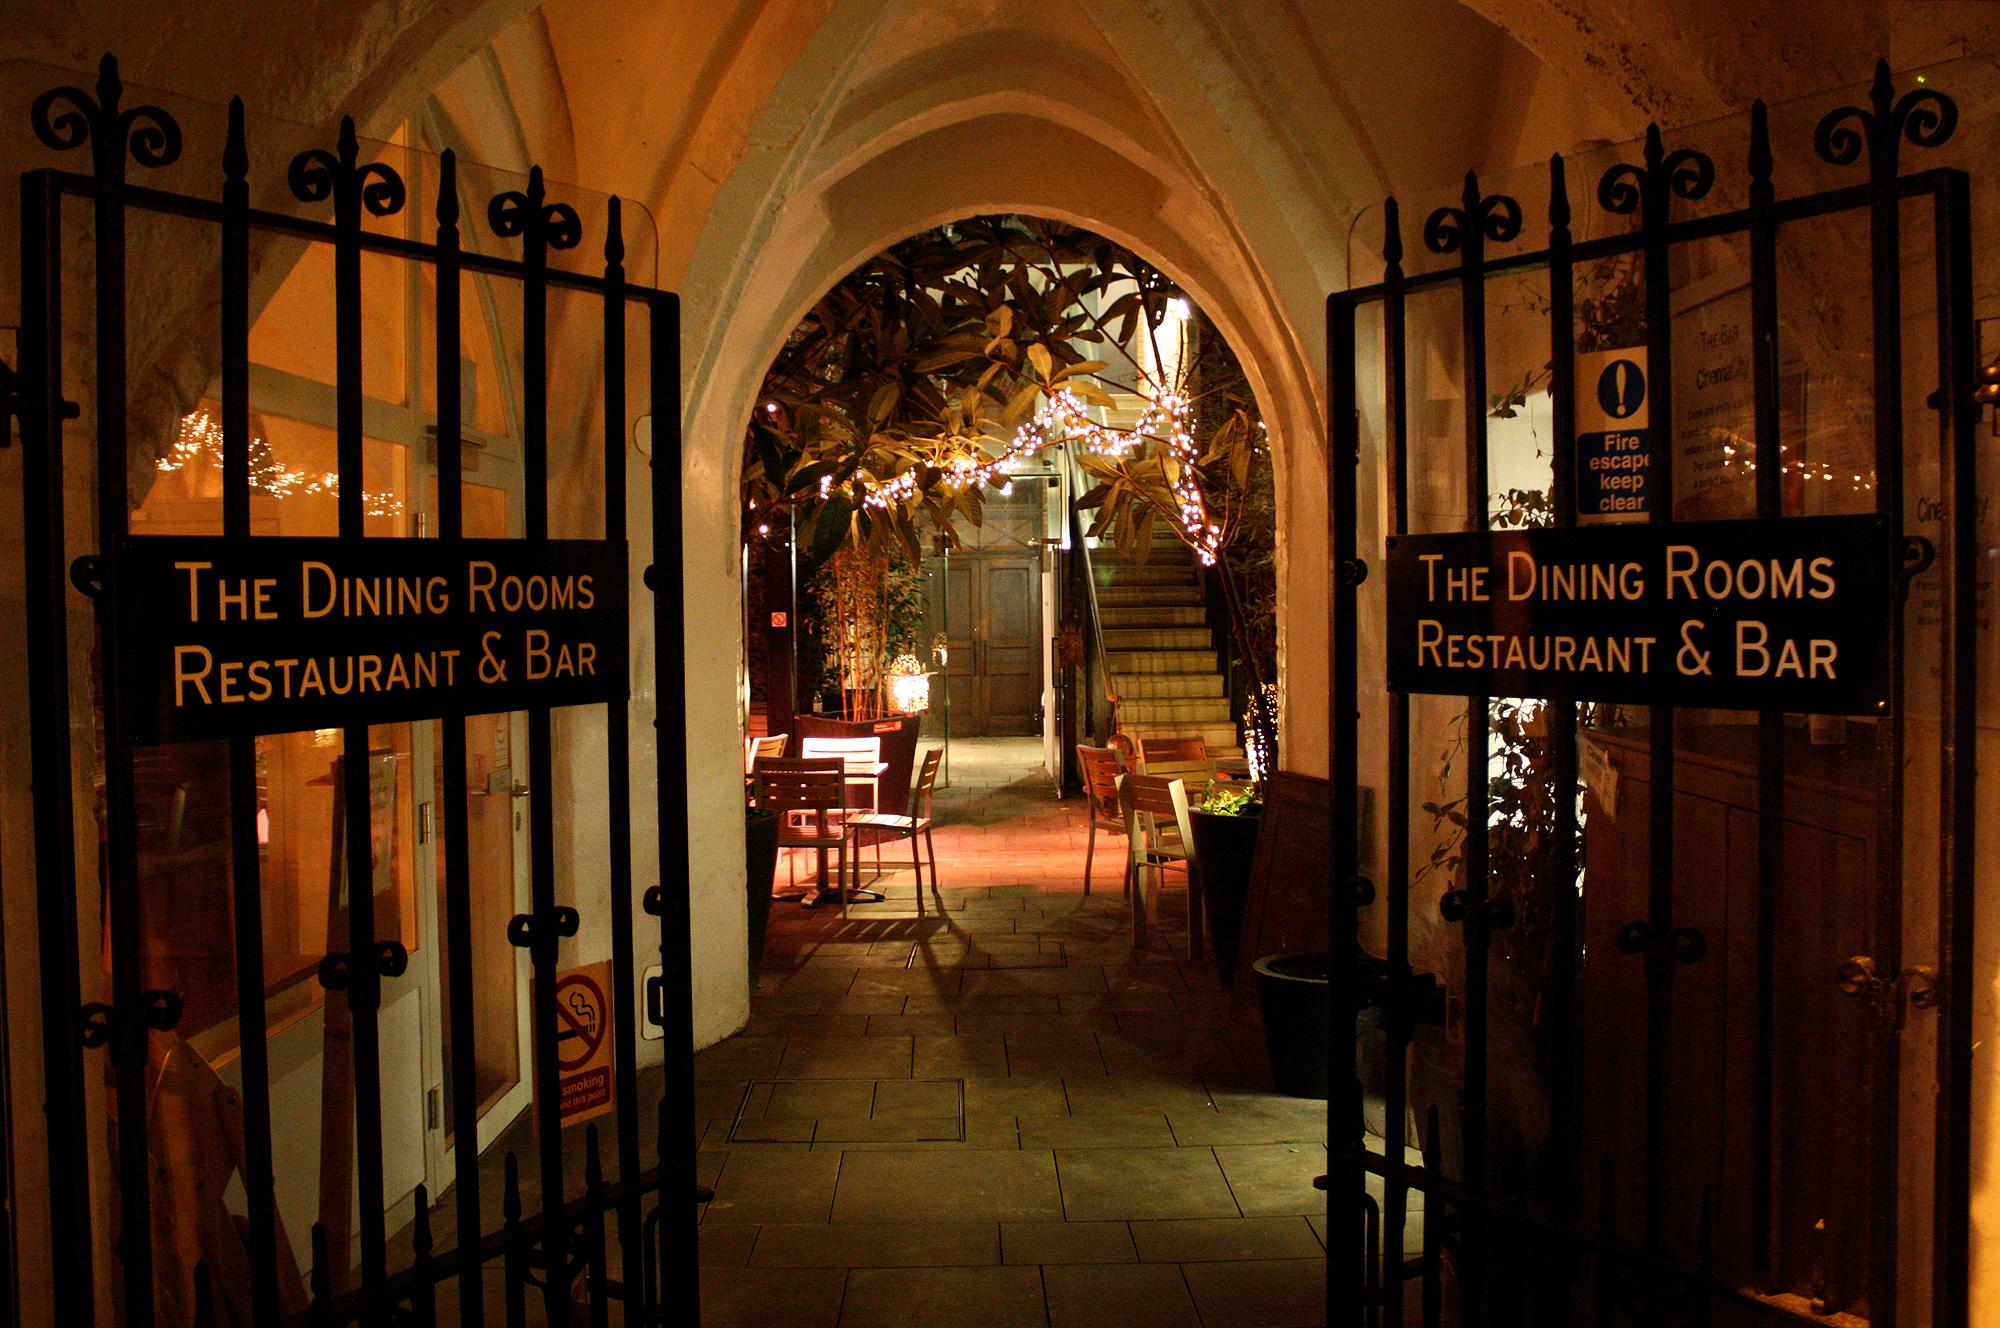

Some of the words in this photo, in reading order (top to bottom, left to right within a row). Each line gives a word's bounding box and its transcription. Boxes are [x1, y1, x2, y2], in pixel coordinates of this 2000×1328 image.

[1605, 433, 1640, 451] Fire
[1598, 493, 1645, 511] clear
[1599, 473, 1645, 492] keep
[175, 560, 278, 624] THE
[302, 560, 449, 620] DINING
[469, 560, 595, 614] ROOMS
[1419, 552, 1490, 602] THE
[1508, 549, 1644, 602] DINING
[1666, 545, 1836, 601] ROOMS
[174, 643, 460, 708] RESTAURANT
[478, 630, 507, 684] &
[526, 628, 597, 682] BAR
[1418, 619, 1657, 675] RESTAURANT
[1677, 618, 1712, 677] &
[1736, 620, 1838, 681] BAR
[562, 1074, 604, 1096] smoking
